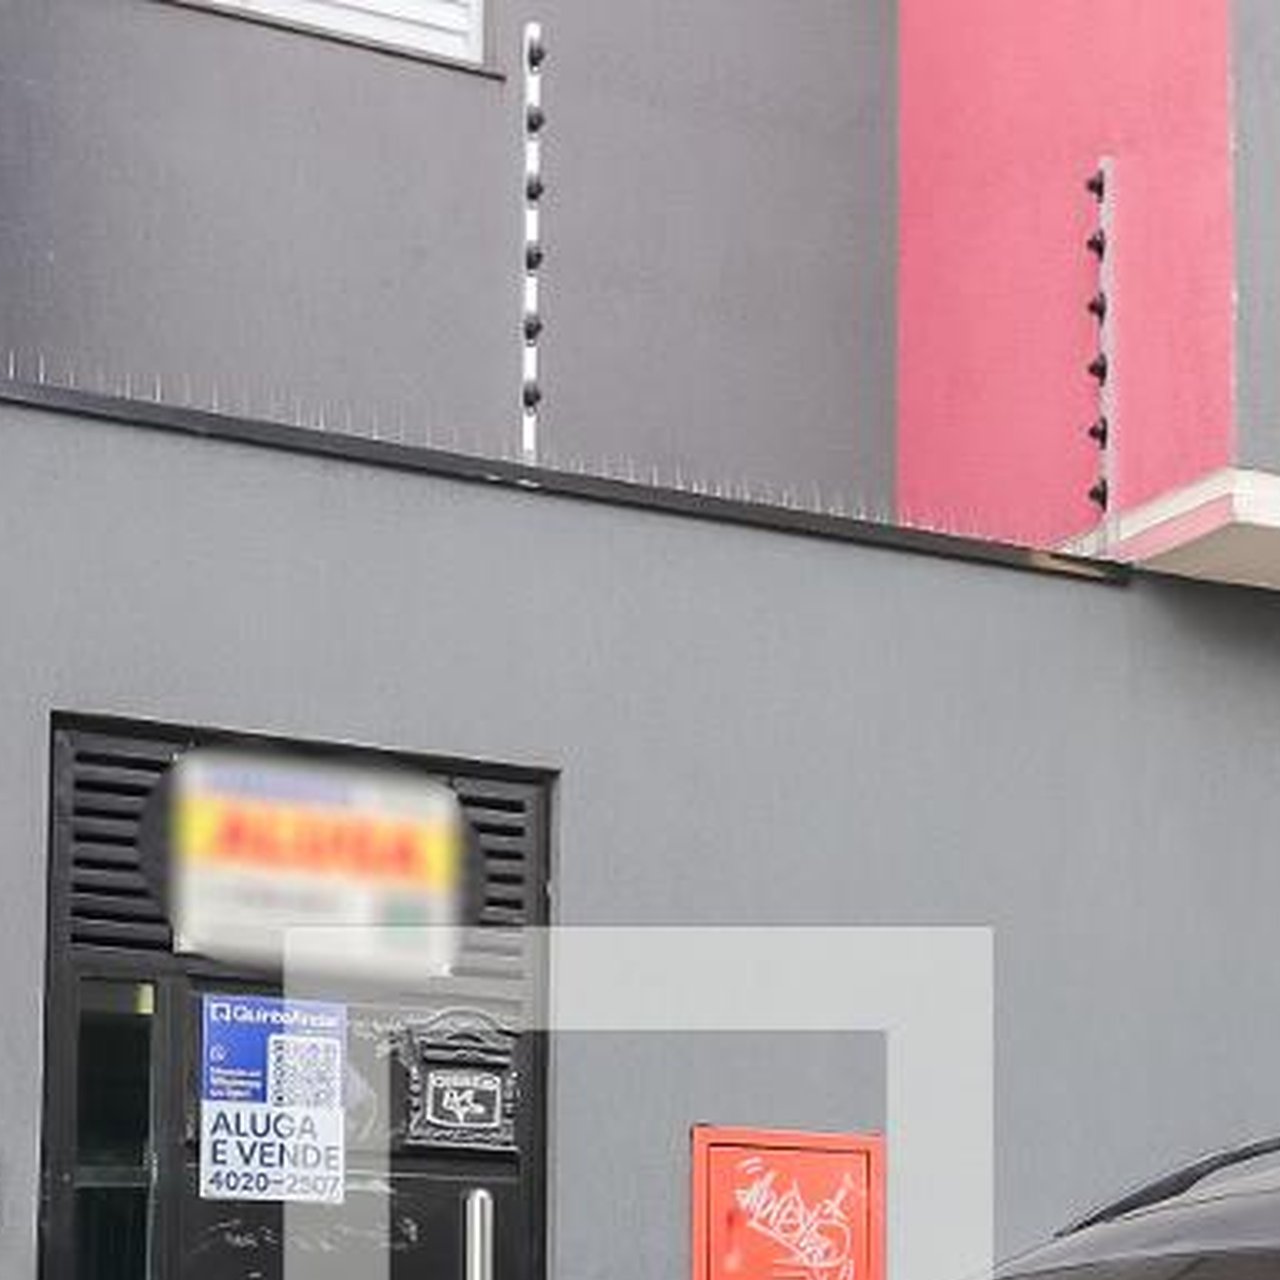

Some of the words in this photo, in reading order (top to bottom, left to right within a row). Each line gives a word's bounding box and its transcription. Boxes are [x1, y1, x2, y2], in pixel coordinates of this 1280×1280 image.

[210, 1111, 316, 1141] ALUGA
[212, 1139, 228, 1165] E
[236, 1140, 340, 1170] VENDE
